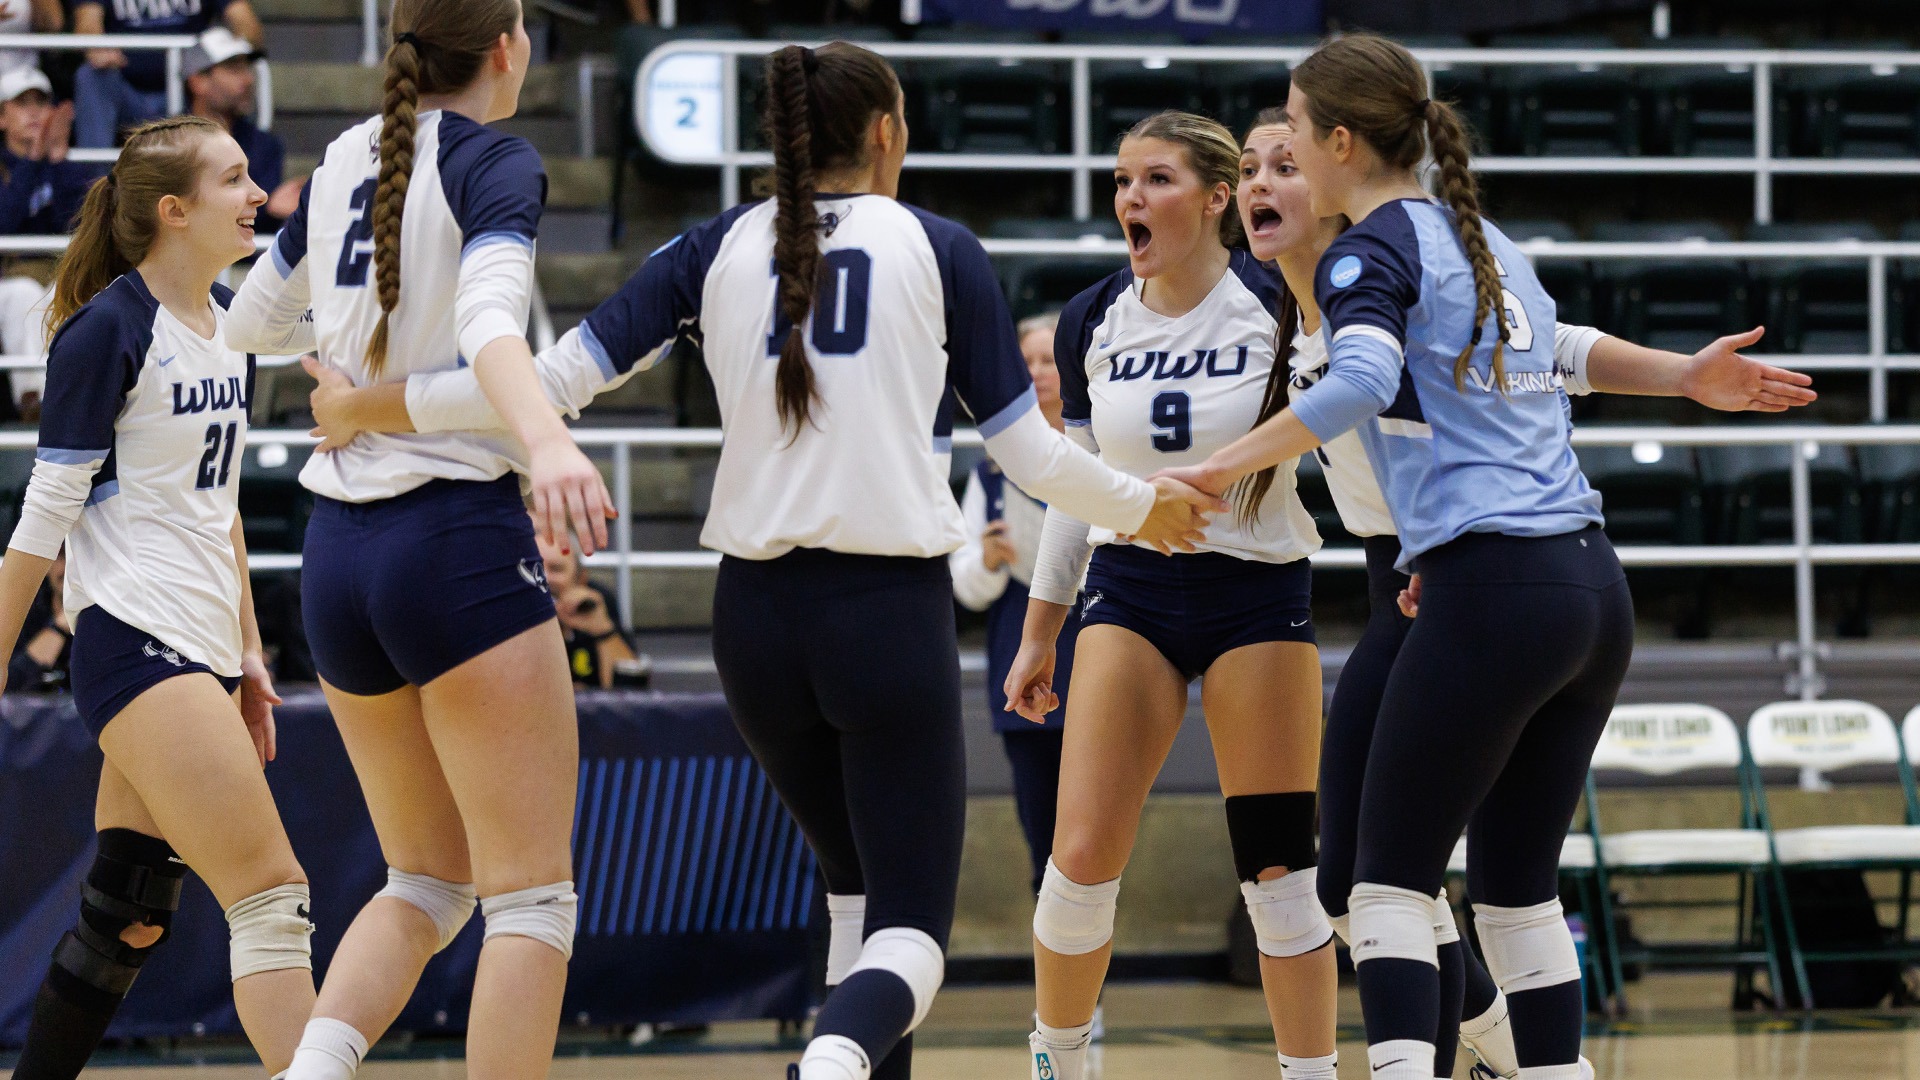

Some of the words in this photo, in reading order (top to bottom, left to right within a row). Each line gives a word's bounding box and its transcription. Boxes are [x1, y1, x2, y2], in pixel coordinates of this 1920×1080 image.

[676, 97, 699, 127] 2
[1108, 345, 1249, 382] WWU
[1467, 365, 1556, 393] VKIN
[1150, 390, 1193, 453] 9
[195, 421, 238, 491] 21
